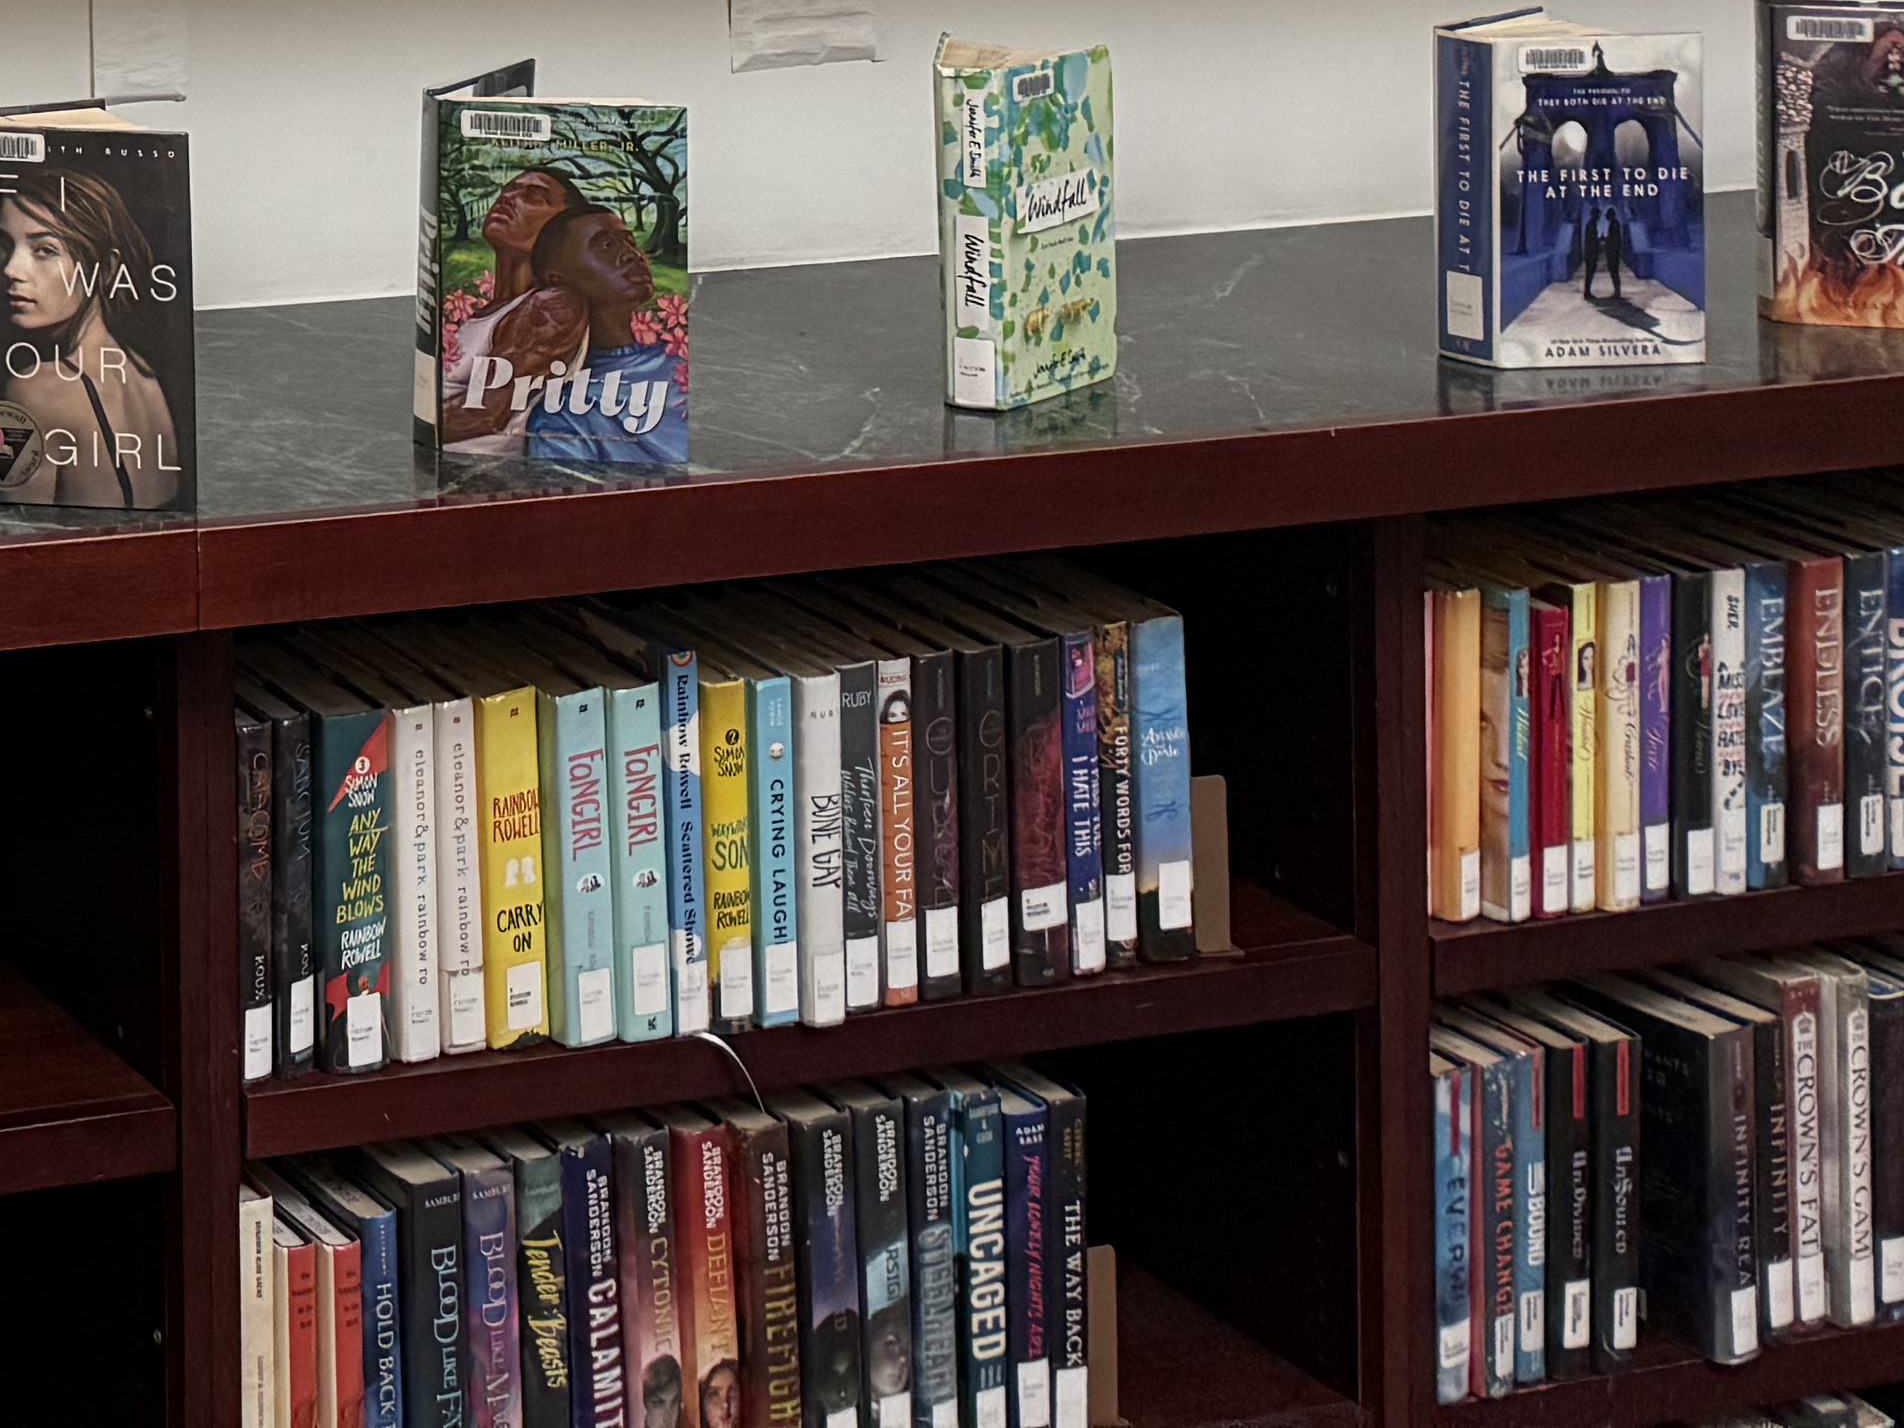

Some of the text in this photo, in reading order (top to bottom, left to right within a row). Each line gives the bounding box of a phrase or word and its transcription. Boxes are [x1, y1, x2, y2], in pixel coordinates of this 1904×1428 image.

[104, 148, 175, 158] RUSSO
[1517, 167, 1689, 183] THE FIRST TO DIE
[1545, 183, 1660, 199] AT THE END
[1026, 176, 1088, 224] Windfall
[58, 261, 178, 302] WAS
[1544, 343, 1662, 359] ADAM SILVERA
[461, 355, 669, 434] Pritty
[44, 428, 182, 471] GIRL
[1116, 726, 1129, 781] FORTY
[769, 778, 786, 858] CRYING
[496, 900, 544, 934] CARRY
[341, 943, 382, 970] ROWELL
[512, 932, 533, 953] ON
[968, 1179, 1006, 1361] UNCAGED
[1064, 1309, 1083, 1368] BACK
